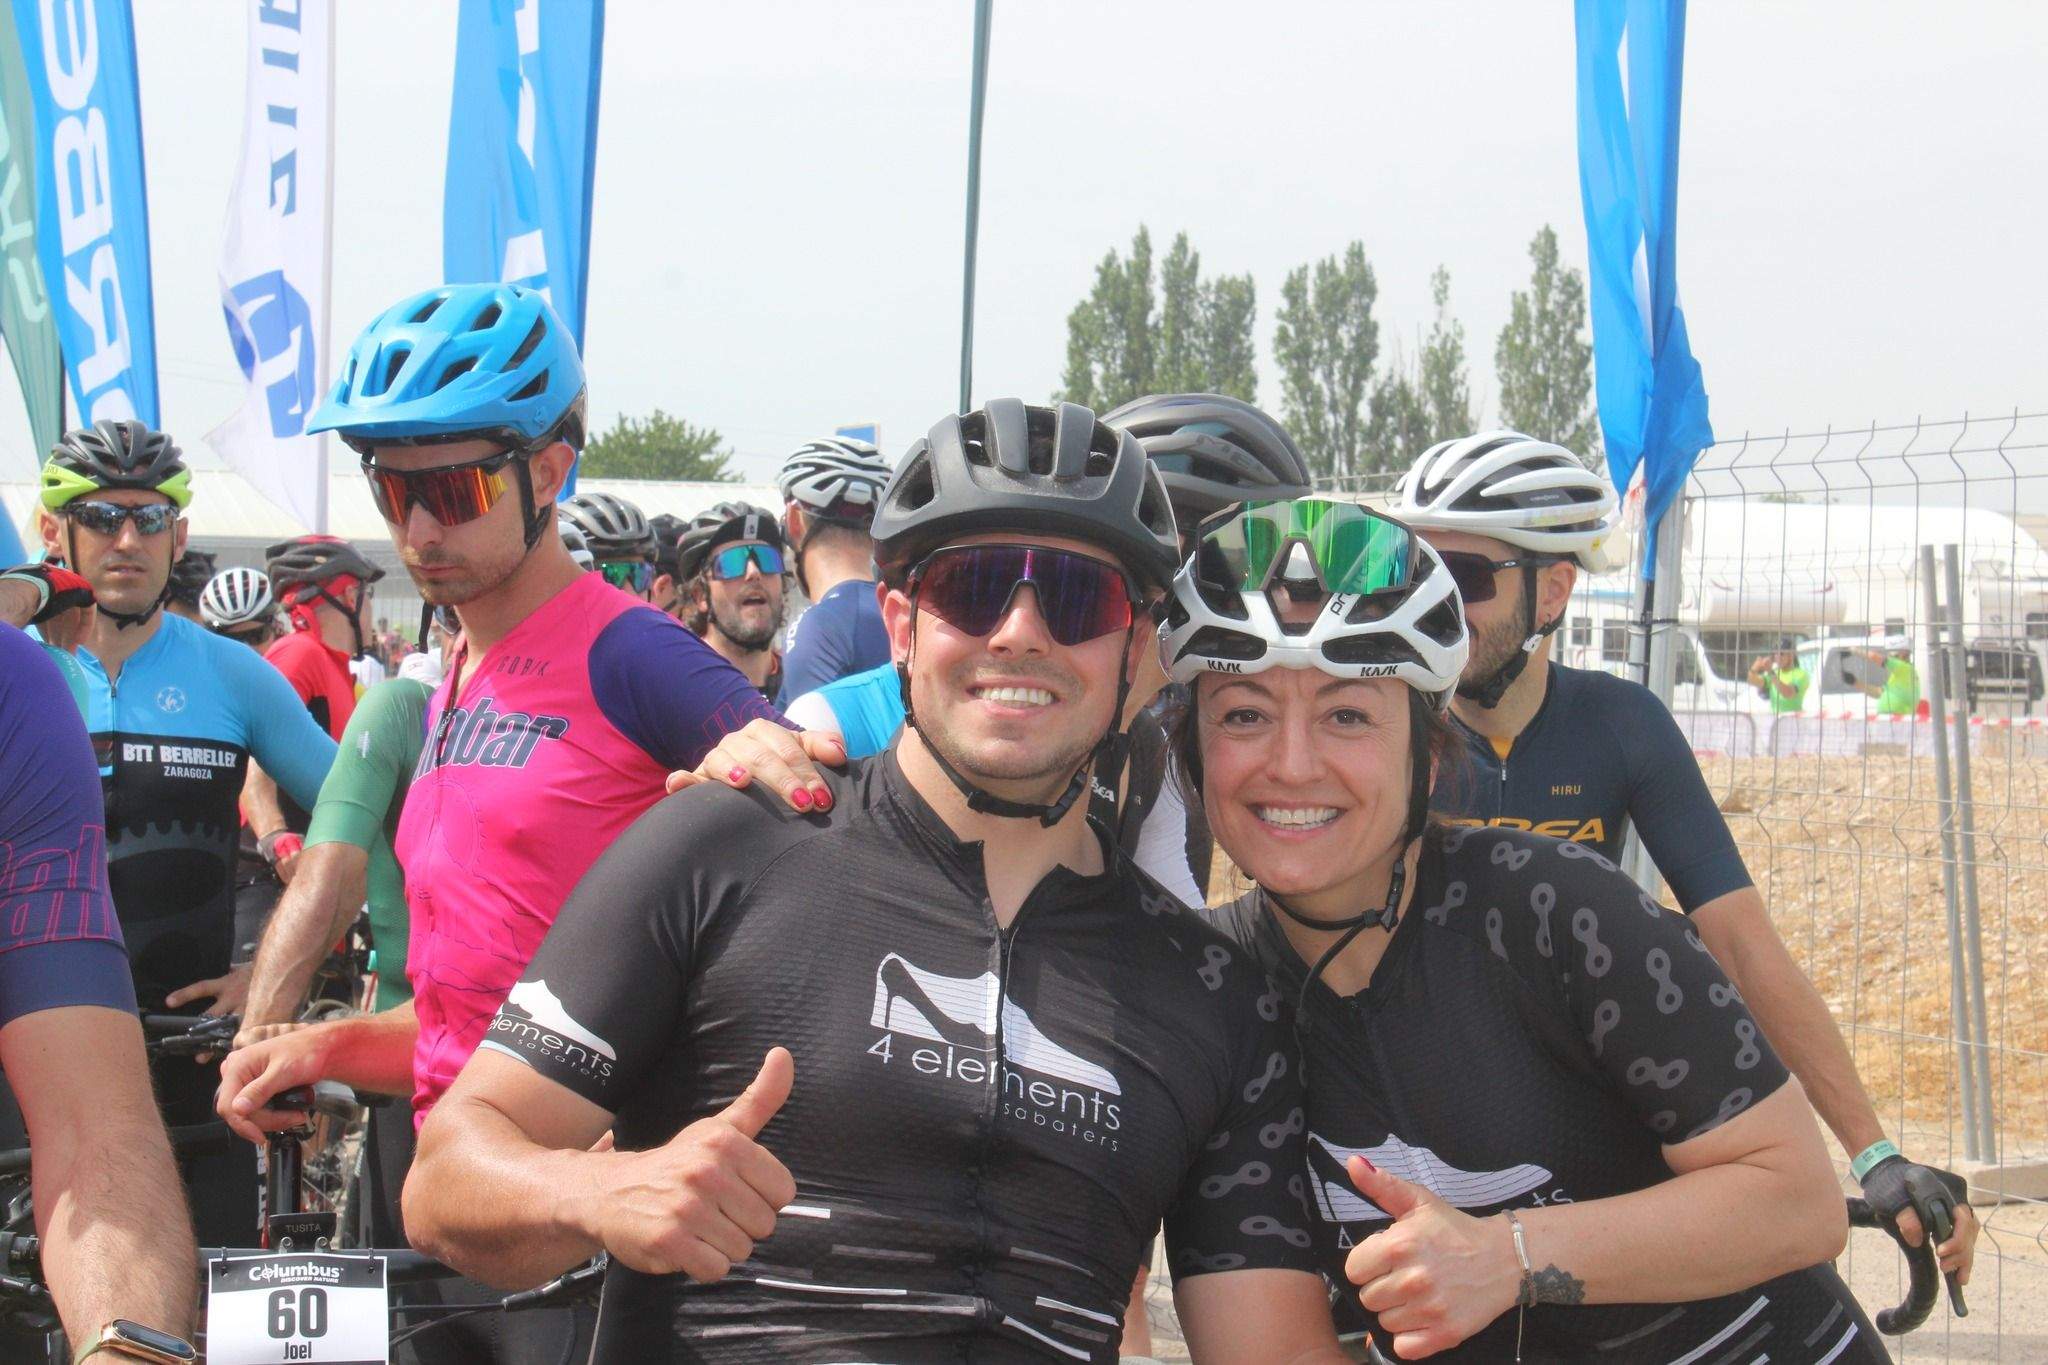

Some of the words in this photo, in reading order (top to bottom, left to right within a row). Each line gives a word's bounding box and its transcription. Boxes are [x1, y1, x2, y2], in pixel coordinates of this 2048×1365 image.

[122, 742, 154, 763] BTT
[163, 765, 213, 780] ZARAGOZA
[1551, 784, 1582, 796] HIRU
[866, 1033, 894, 1064] 4
[911, 1046, 1121, 1131] elements
[1004, 1102, 1119, 1152] sabaters
[285, 1222, 322, 1234] TUSITA
[249, 1262, 341, 1282] Columbus
[280, 1276, 313, 1284] DISCOVER
[313, 1276, 340, 1284] NATURE
[267, 1287, 328, 1339] 60
[283, 1341, 312, 1360] Joel
